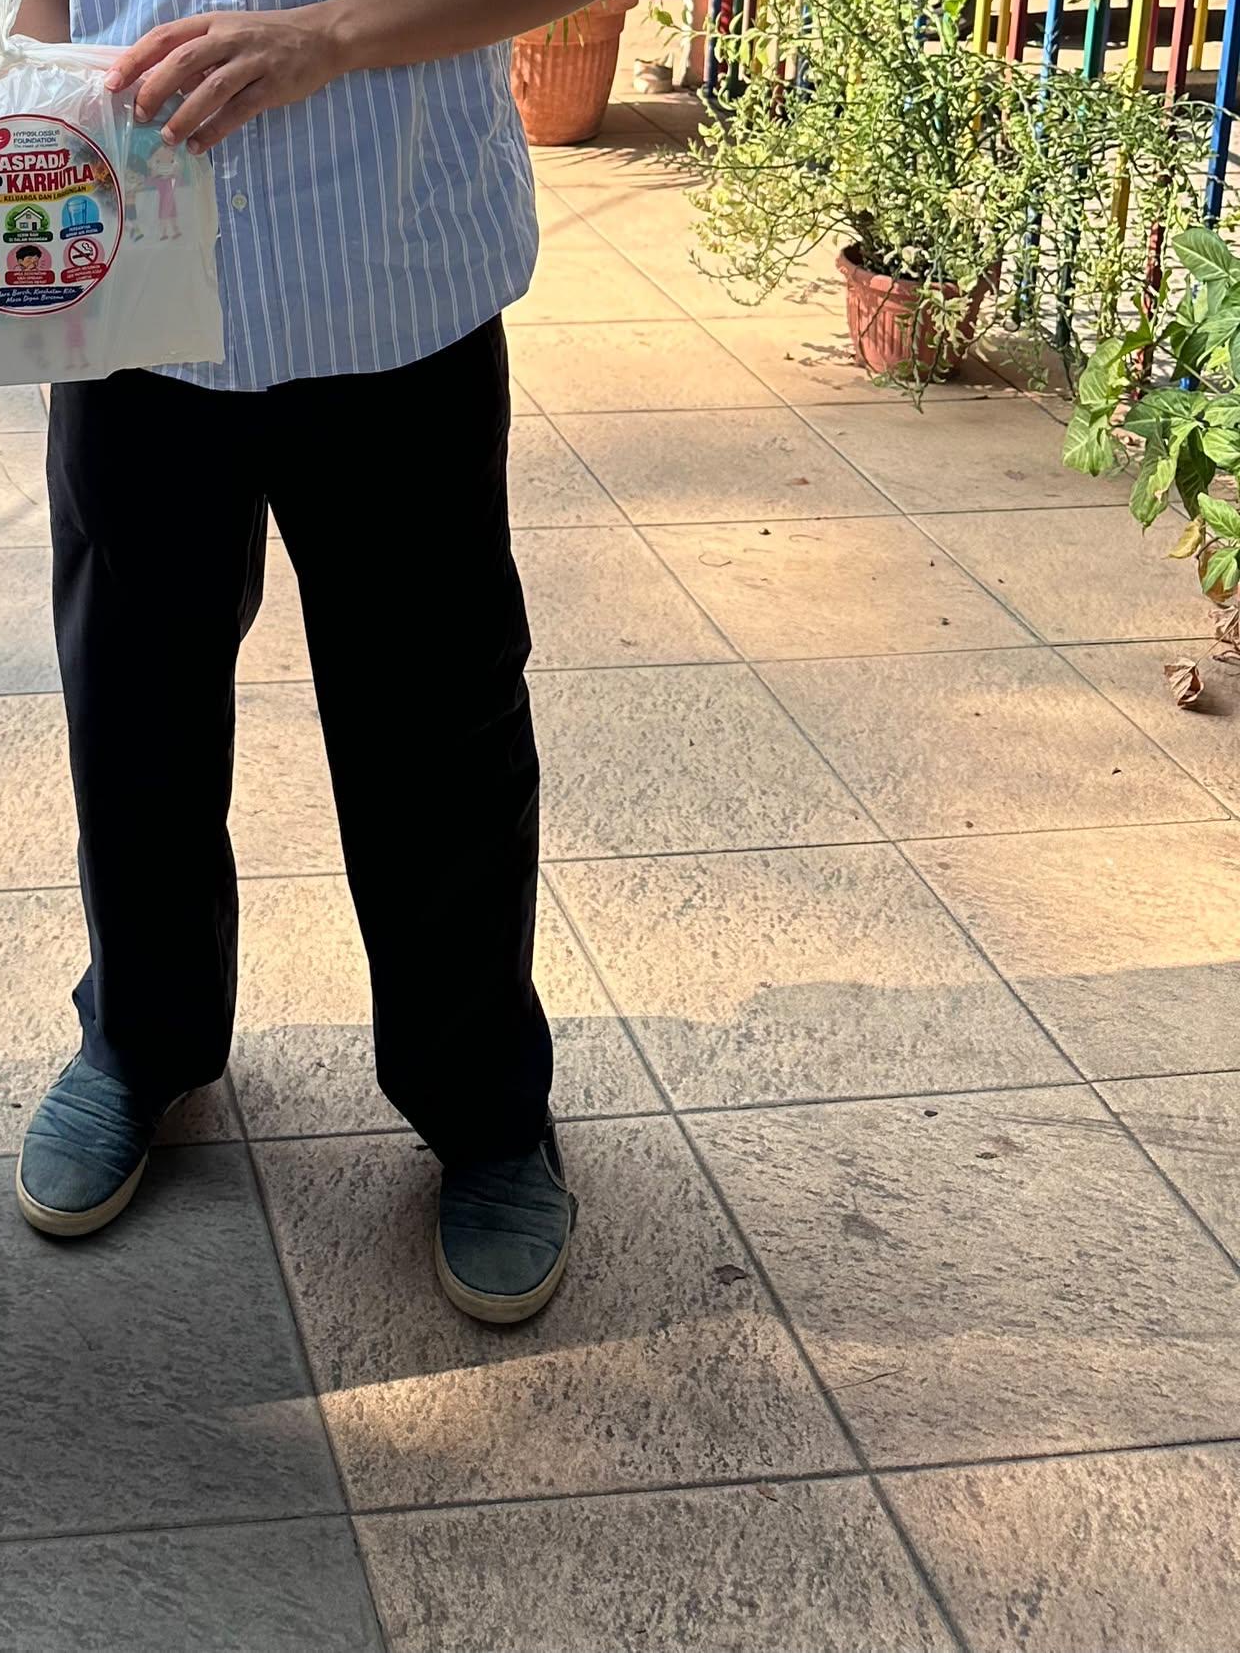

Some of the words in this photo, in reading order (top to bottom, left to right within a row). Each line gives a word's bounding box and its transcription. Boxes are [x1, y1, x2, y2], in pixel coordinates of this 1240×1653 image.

[13, 136, 57, 144] FOUNDATION
[7, 164, 95, 194] KARHUTLA
[3, 194, 38, 202] KELUARGA
